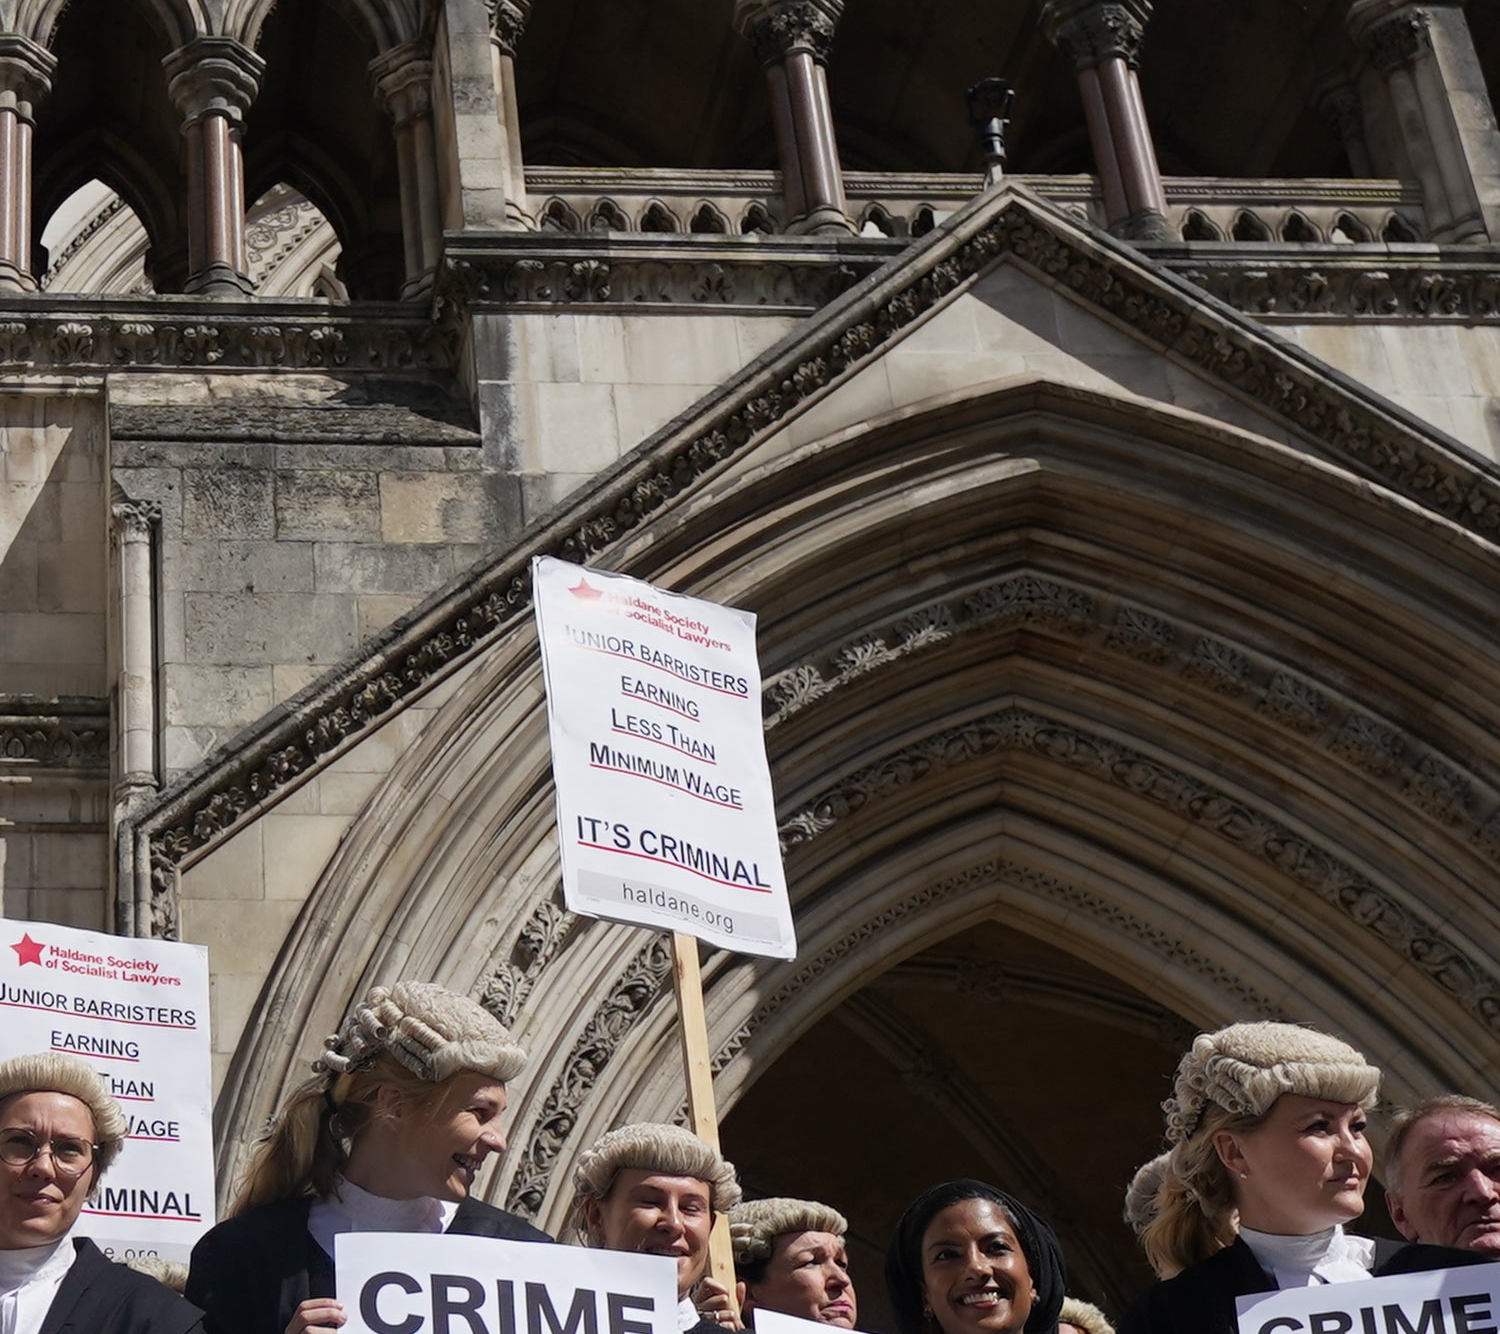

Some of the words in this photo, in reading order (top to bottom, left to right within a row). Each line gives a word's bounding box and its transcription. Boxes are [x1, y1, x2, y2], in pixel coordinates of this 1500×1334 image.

[664, 610, 709, 635] Society
[677, 627, 732, 652] Lawyers
[640, 644, 749, 694] BARRISTERS
[621, 675, 700, 718] EARNING
[611, 708, 664, 740] LESS
[666, 724, 716, 761] THAN
[590, 742, 680, 785] MINIMUM
[683, 768, 743, 807] WAGE
[576, 815, 631, 849] IT'S
[639, 830, 772, 889] CRIMINAL
[622, 883, 734, 933] haldane.org
[45, 959, 59, 968] of
[61, 960, 118, 980] Socialist
[122, 971, 182, 986] Lawyers
[50, 946, 103, 964] Haldane
[107, 955, 159, 973] Society
[73, 996, 197, 1026] BARRISTERS
[50, 1030, 140, 1058] EARNING
